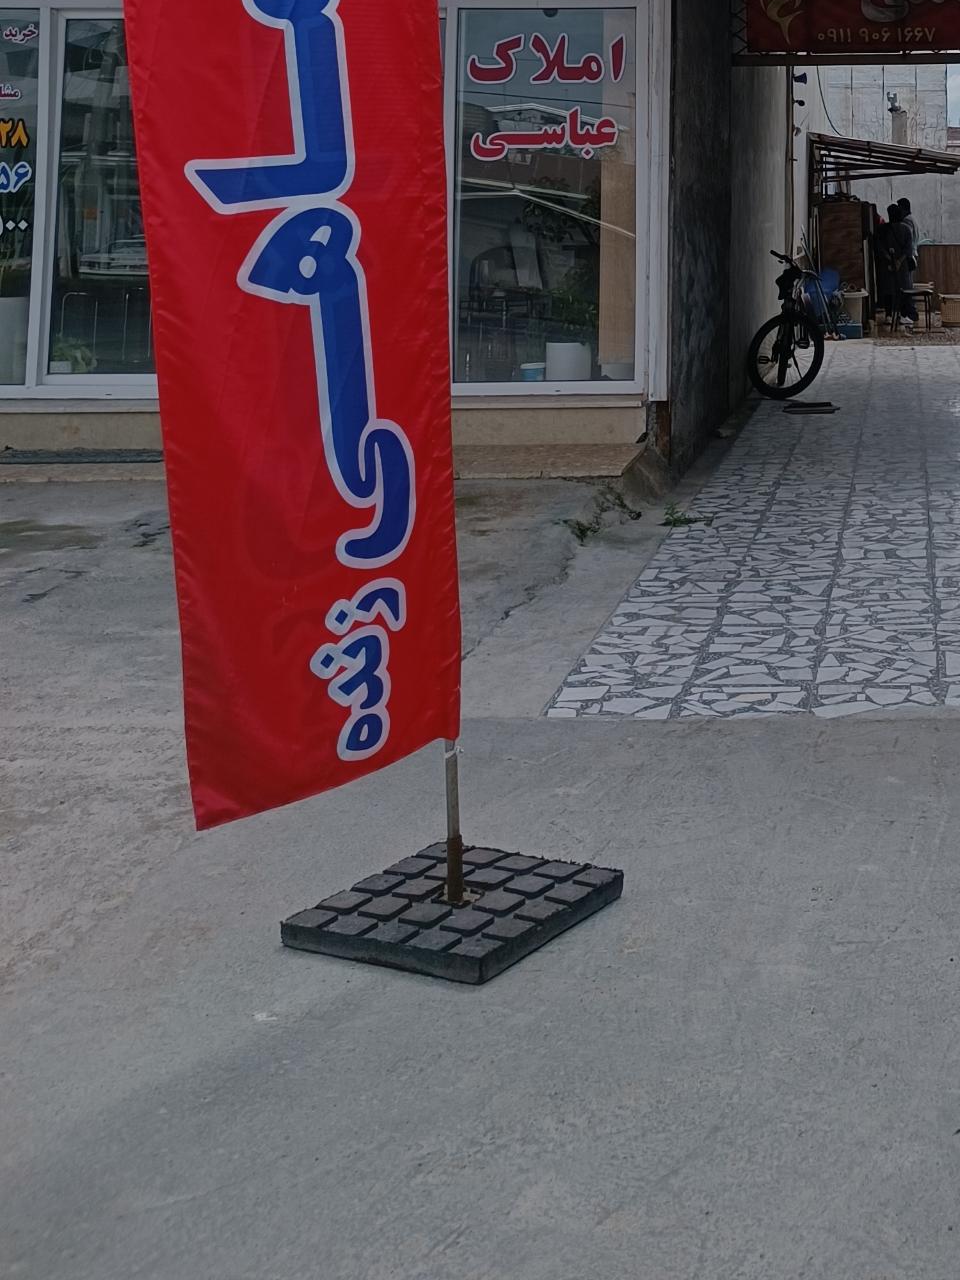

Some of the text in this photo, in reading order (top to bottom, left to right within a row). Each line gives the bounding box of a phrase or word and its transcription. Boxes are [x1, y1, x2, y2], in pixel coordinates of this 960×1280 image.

[466, 32, 627, 84] املاک
[470, 106, 619, 161] عباسی
[309, 577, 407, 762] زنده
